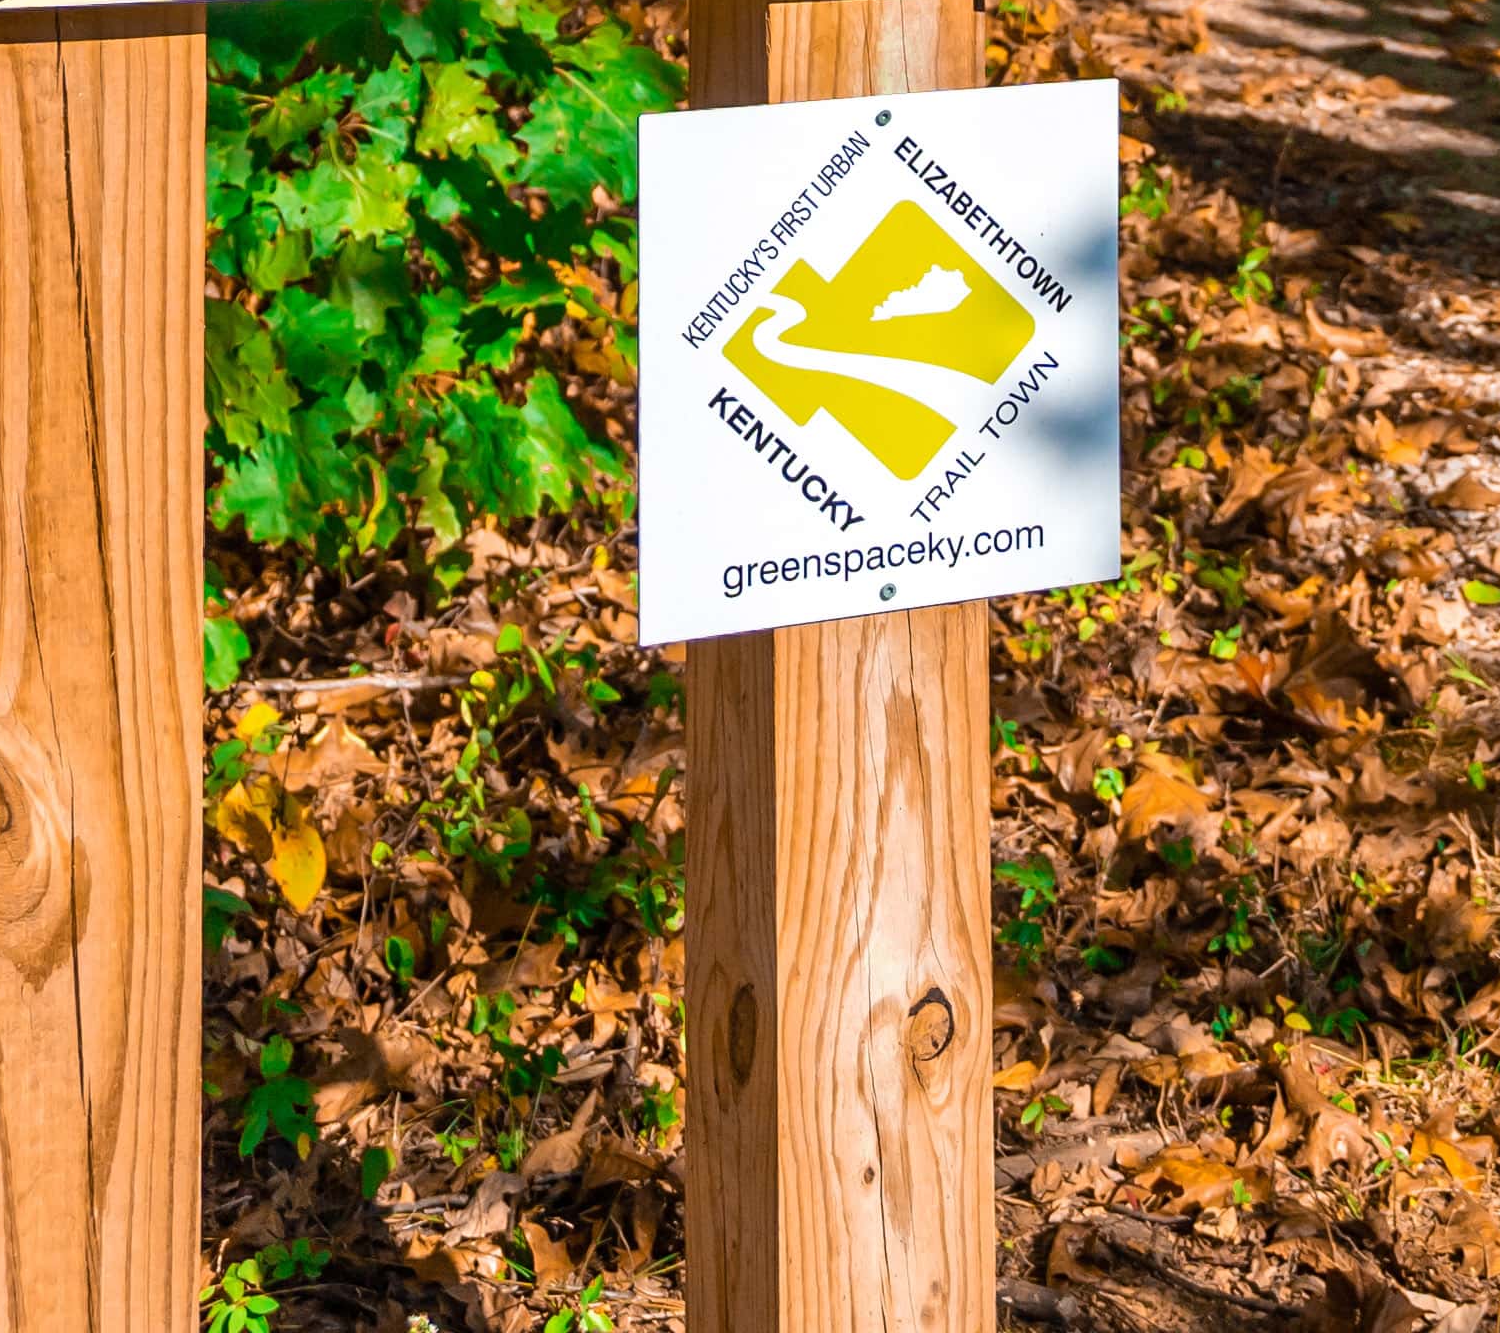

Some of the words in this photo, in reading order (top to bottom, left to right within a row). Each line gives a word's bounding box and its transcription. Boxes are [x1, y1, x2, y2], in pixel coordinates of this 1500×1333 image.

[682, 239, 780, 349] KENTUCKY'S
[770, 188, 820, 248] FIRST
[811, 130, 872, 197] URBAN
[893, 136, 1073, 314] ELIZABETHTOWN
[708, 387, 865, 533] KENTUCKY
[910, 450, 986, 525] TRAIL
[980, 350, 1060, 441] TOWN
[722, 523, 1045, 598] greenspaceky.com
